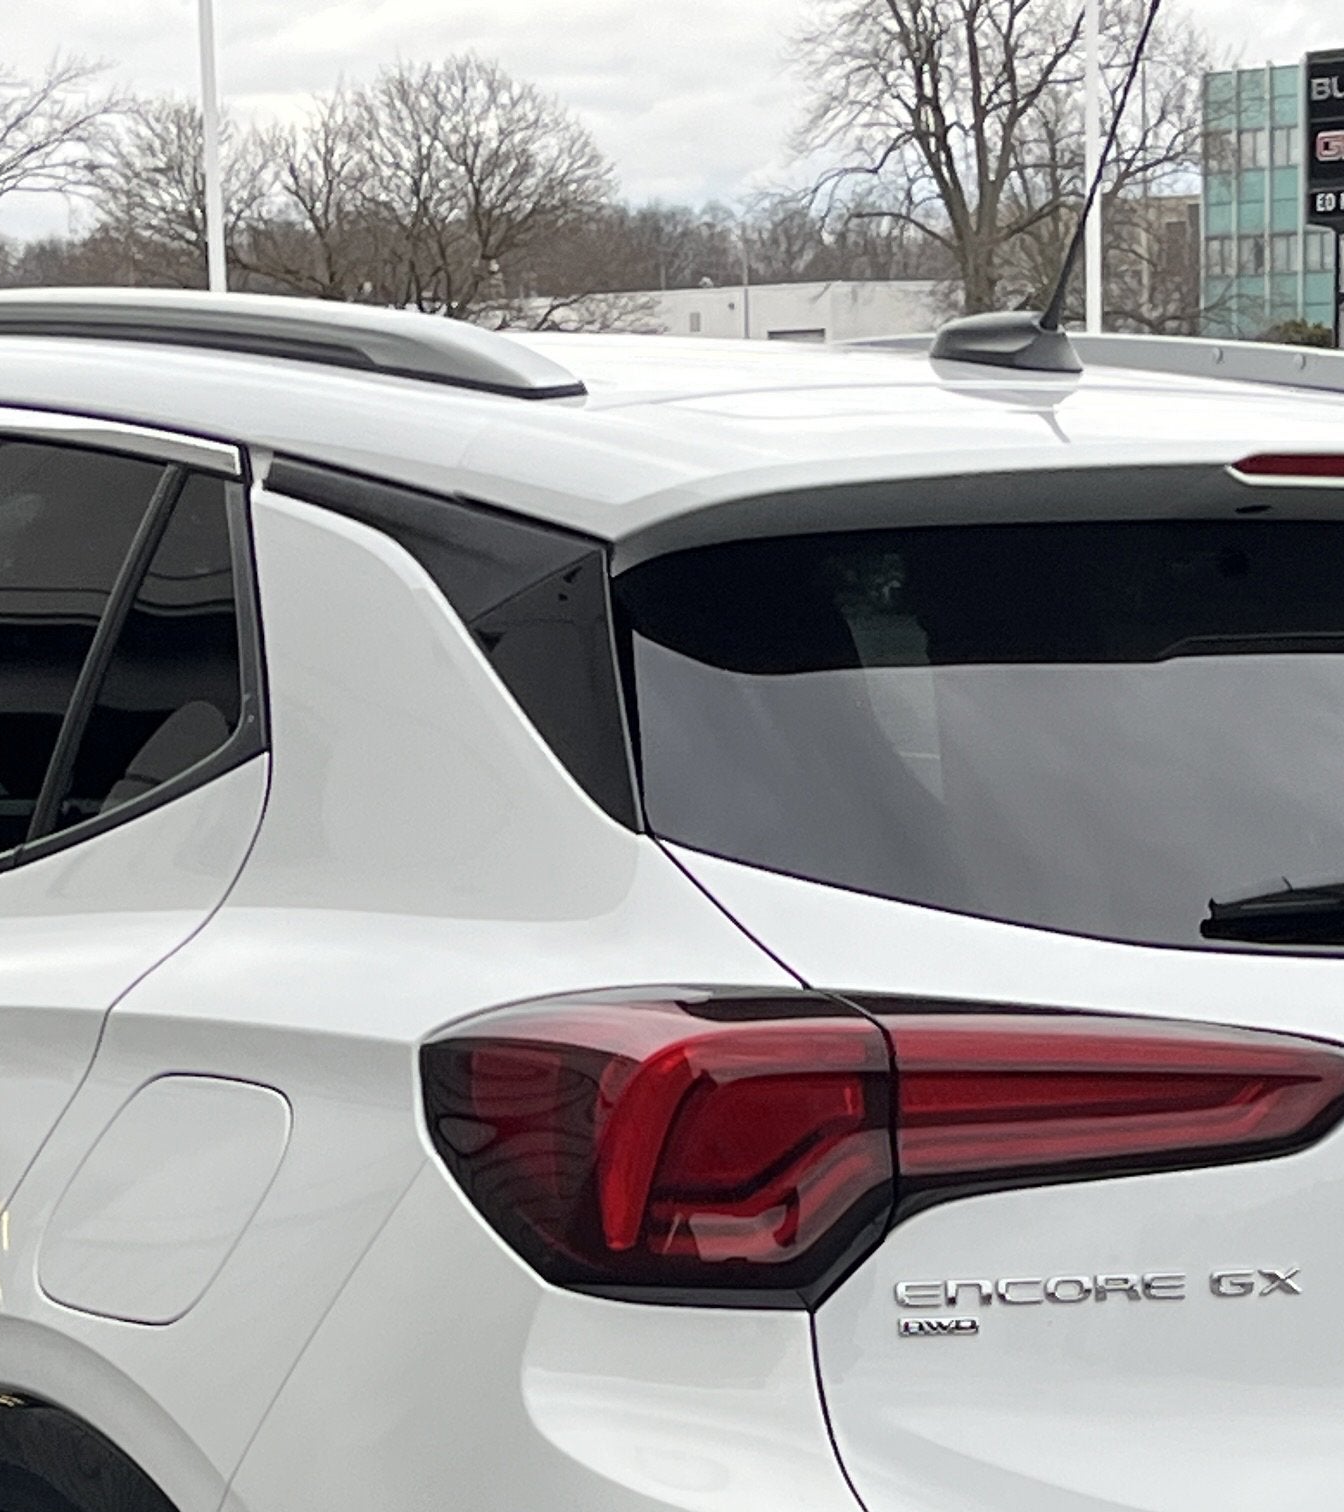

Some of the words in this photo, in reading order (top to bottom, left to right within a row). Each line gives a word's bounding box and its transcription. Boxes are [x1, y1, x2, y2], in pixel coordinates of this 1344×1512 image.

[1316, 194, 1334, 212] ED
[894, 1273, 1187, 1308] ENCORE
[1209, 1267, 1303, 1298] GX
